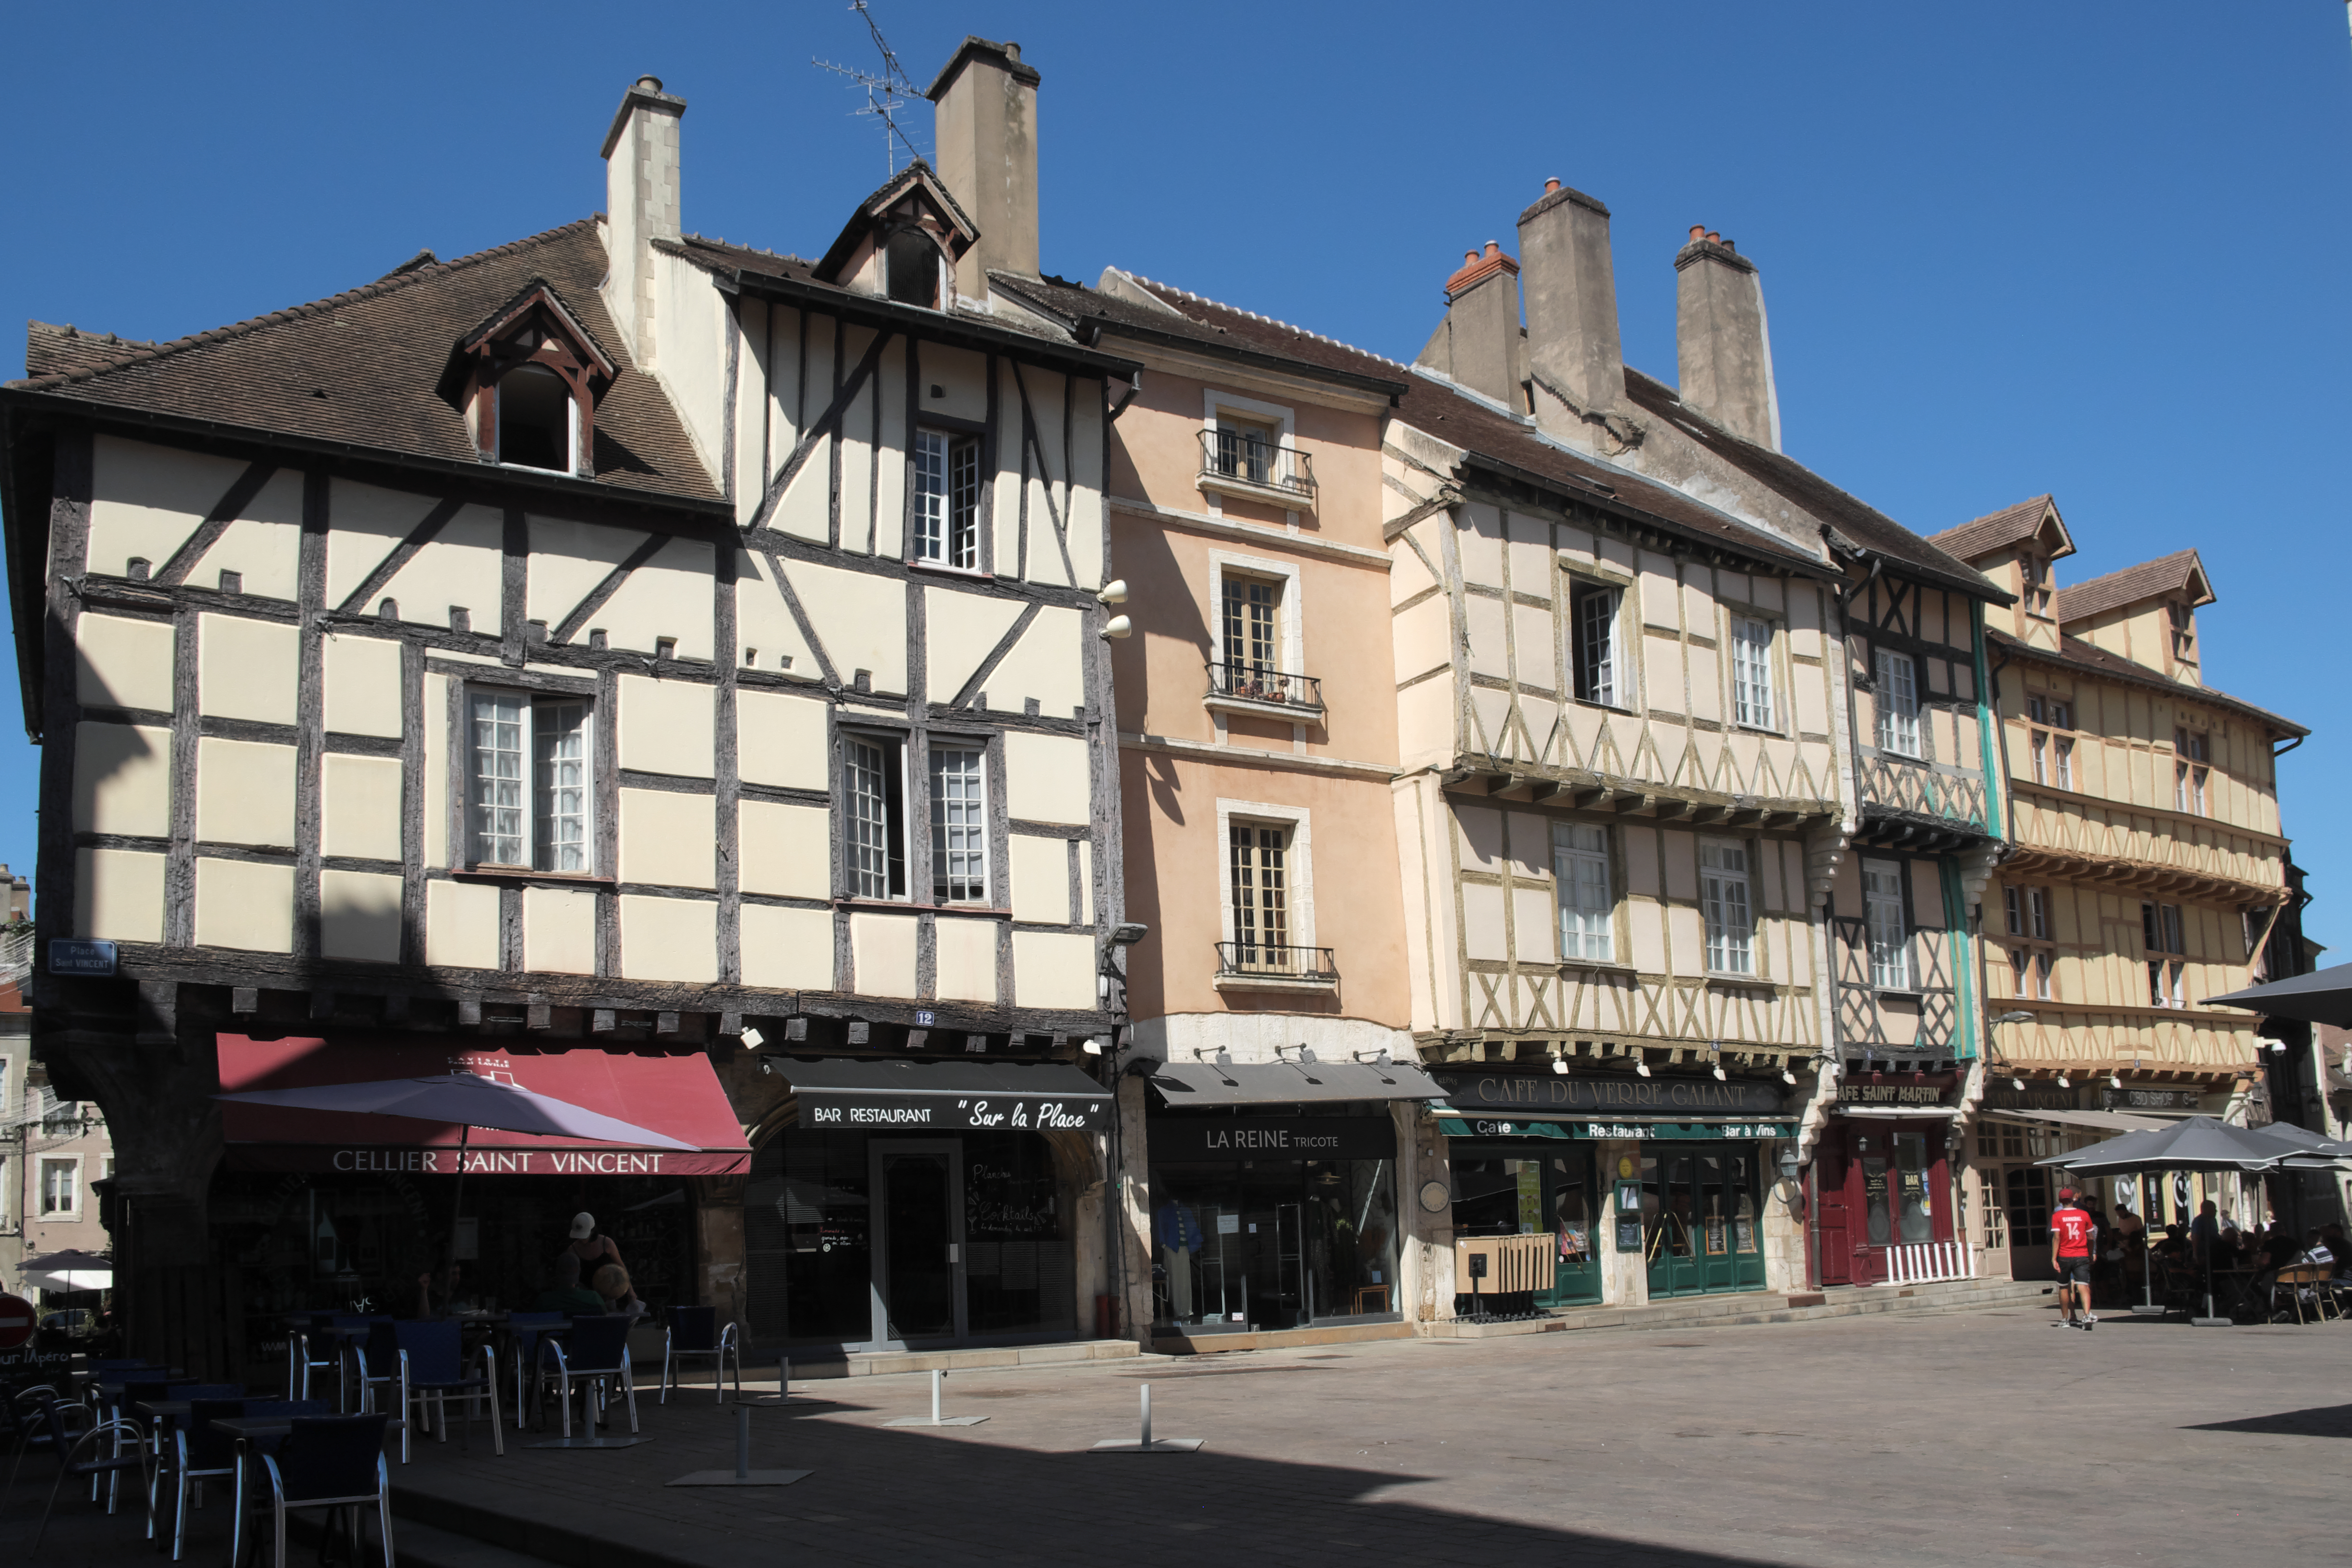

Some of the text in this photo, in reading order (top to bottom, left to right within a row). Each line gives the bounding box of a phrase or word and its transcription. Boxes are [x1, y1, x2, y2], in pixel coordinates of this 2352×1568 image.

[71, 946, 95, 955] Place
[55, 958, 108, 969] Saint VINCENT
[918, 1012, 932, 1024] 12
[1438, 1076, 1458, 1086] REPAS
[1478, 1078, 1538, 1103] CAFE
[1549, 1081, 1579, 1104] DU
[1590, 1082, 1662, 1105] VERRE
[1671, 1084, 1746, 1107] GALANT
[1837, 1086, 1940, 1103] AFE SAINT MARTIN
[2027, 1092, 2073, 1108] VINCENT
[2129, 1091, 2173, 1106] CBD SHOP
[814, 1108, 931, 1123] BAR RESTAURANT
[1011, 1103, 1027, 1128] la
[1476, 1119, 1511, 1135] Café
[1589, 1123, 1655, 1138] Restaurant
[1722, 1124, 1777, 1137] Bar à Vins
[1207, 1130, 1339, 1148] LA REINE TRICOTE
[332, 1150, 664, 1172] CELLIER SAINT VINCENT
[1905, 1174, 1919, 1186] BAR
[979, 1201, 1034, 1222] Cocktails
[2066, 1222, 2080, 1240] 14
[0, 1354, 21, 1365] ur
